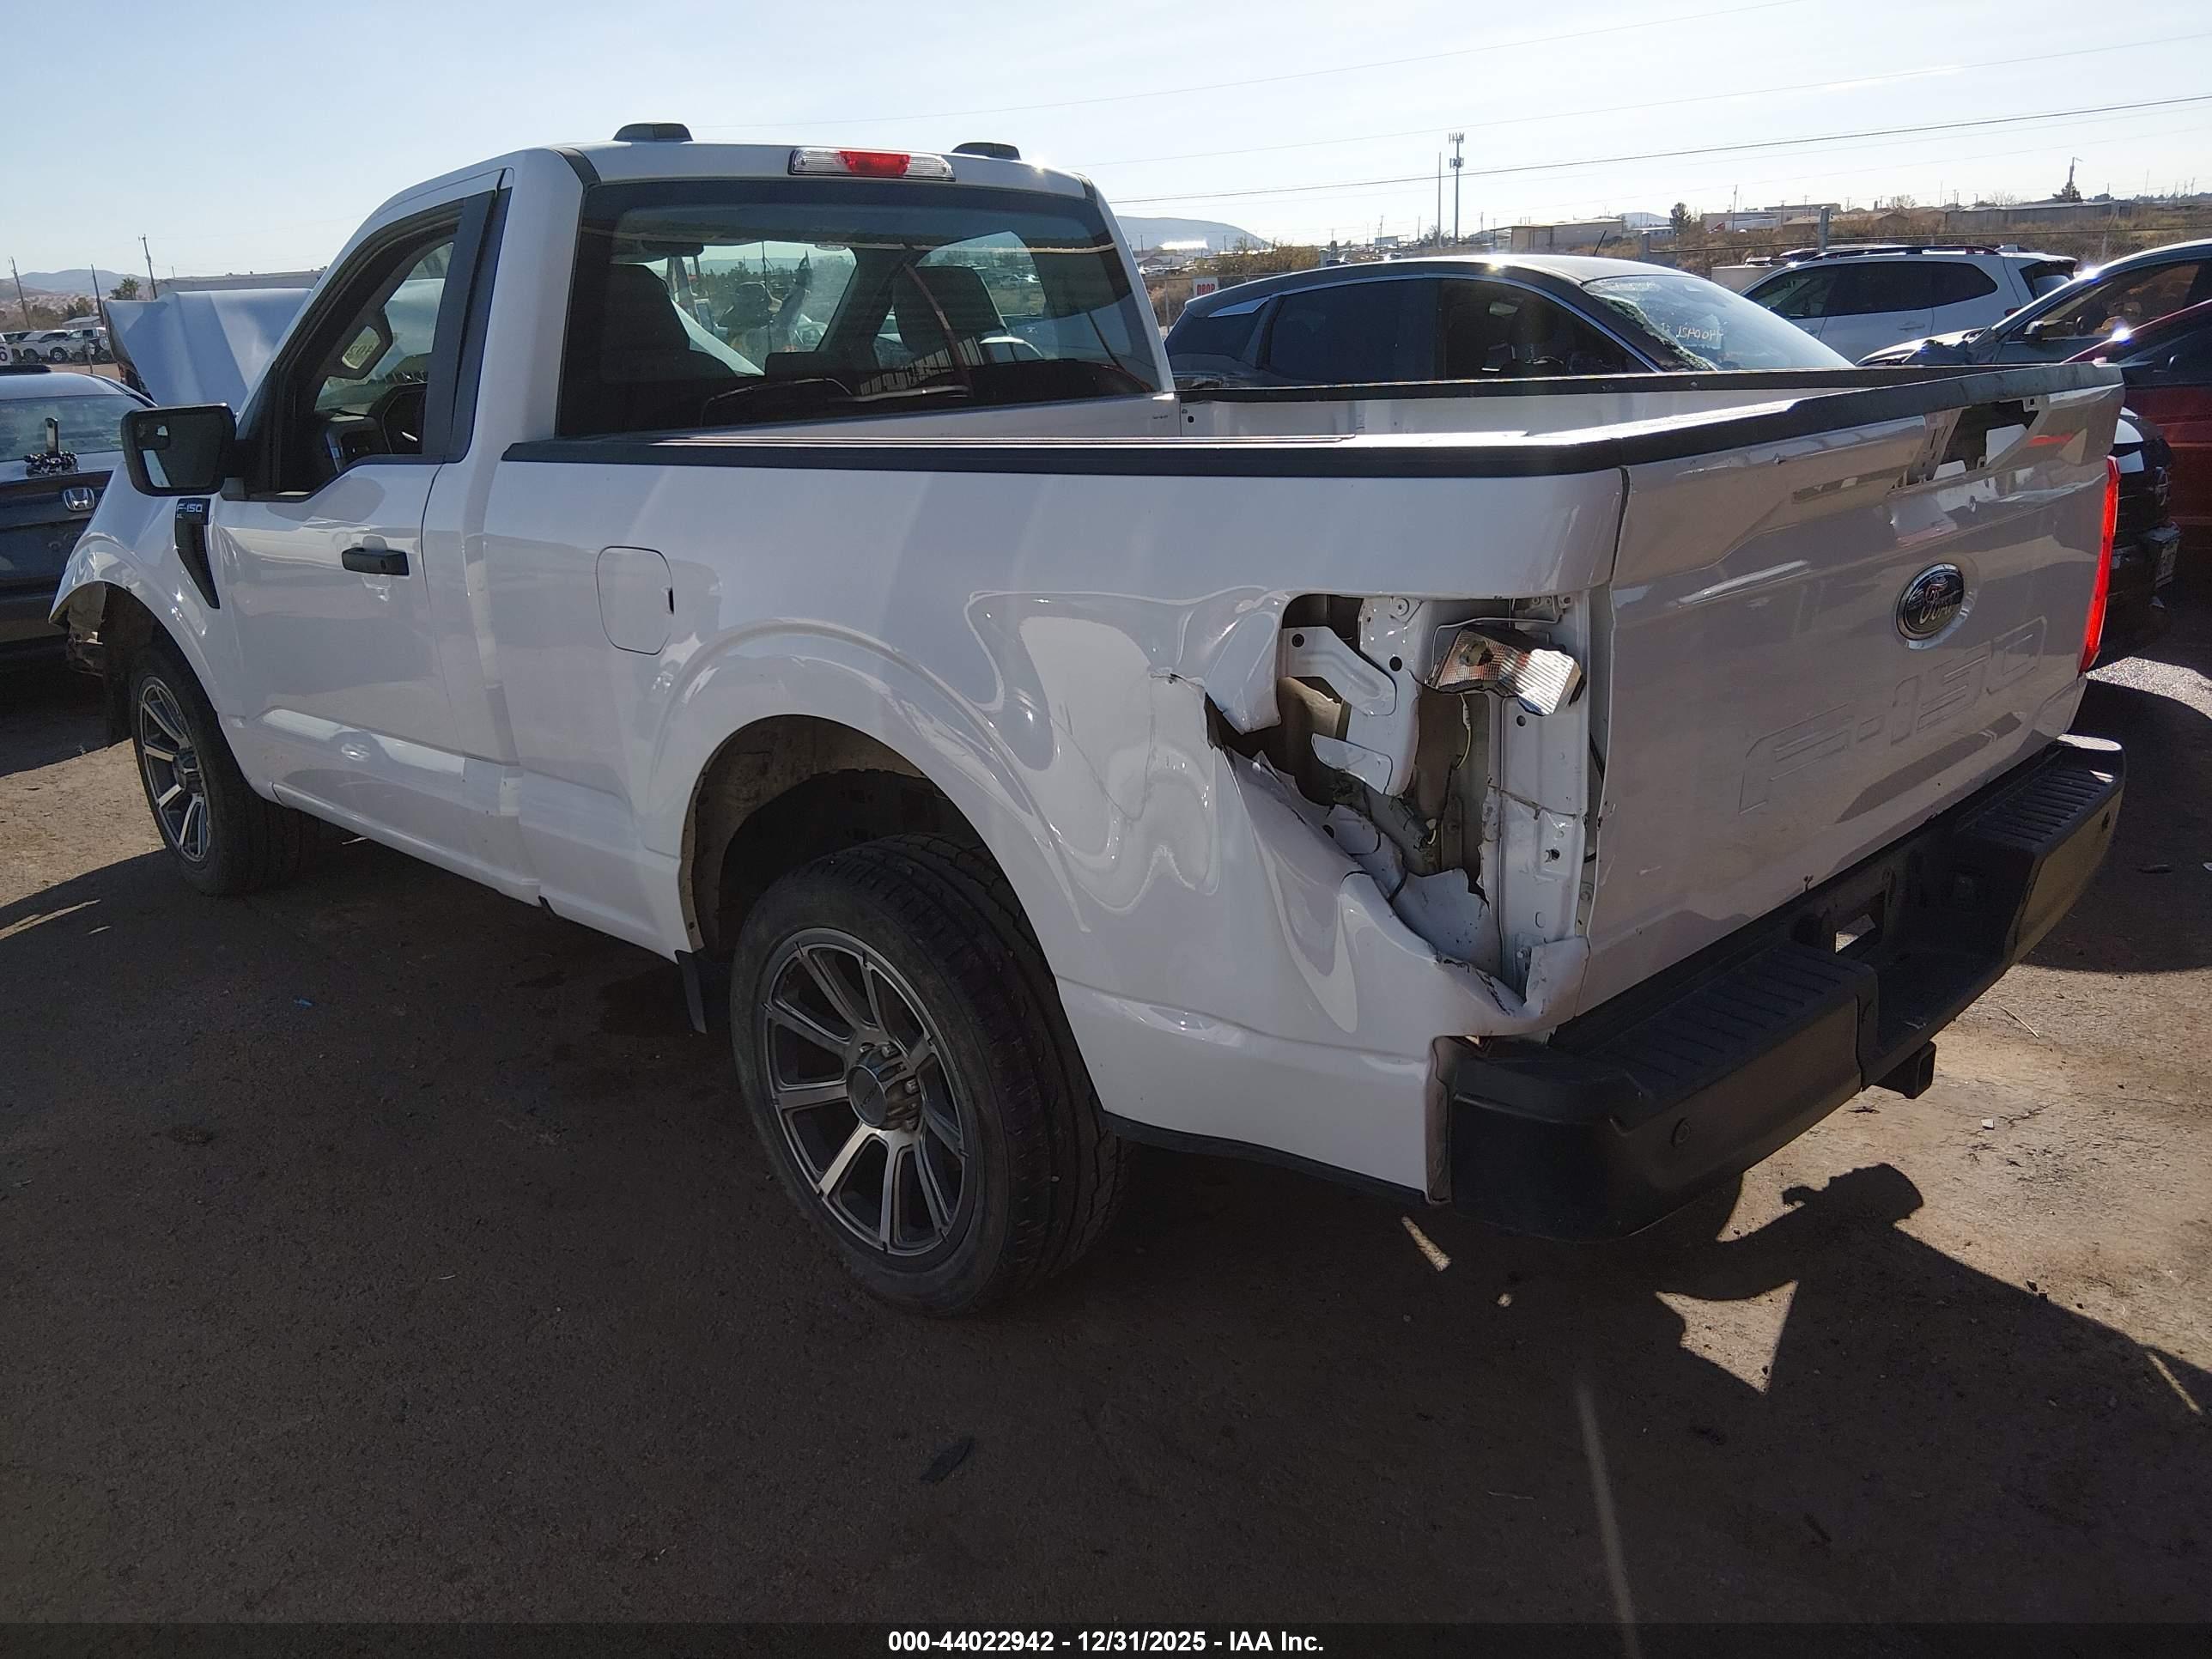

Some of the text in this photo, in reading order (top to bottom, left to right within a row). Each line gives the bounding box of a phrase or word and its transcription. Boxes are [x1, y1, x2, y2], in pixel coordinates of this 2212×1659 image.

[176, 502, 203, 514] F-150
[1918, 580, 1954, 624] Ford
[1739, 615, 2048, 806] F-150
